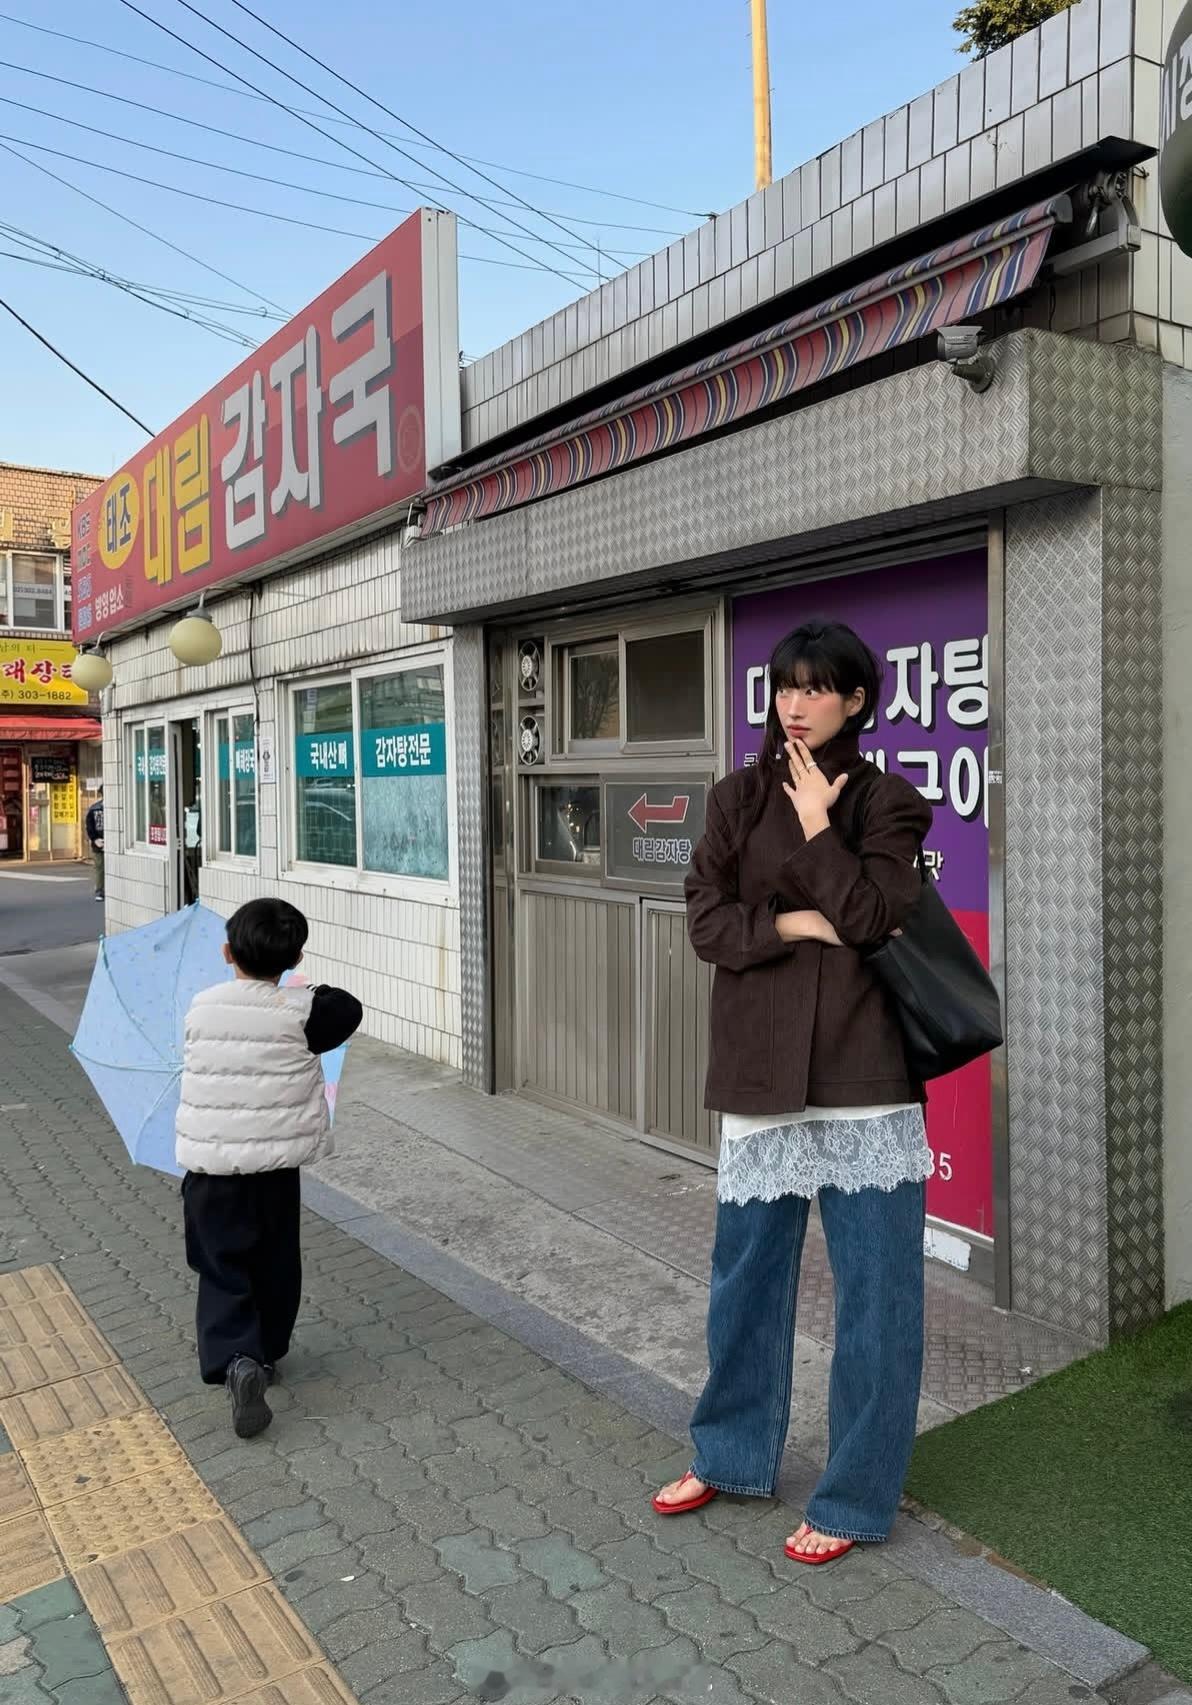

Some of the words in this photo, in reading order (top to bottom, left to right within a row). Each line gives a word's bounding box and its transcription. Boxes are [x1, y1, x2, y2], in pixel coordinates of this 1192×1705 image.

[143, 412, 211, 586] 대림
[220, 269, 393, 551] 감자국
[18, 690, 72, 701] 303-1882
[375, 733, 432, 768] 감자탕전문
[633, 837, 692, 864] 대림감자탕
